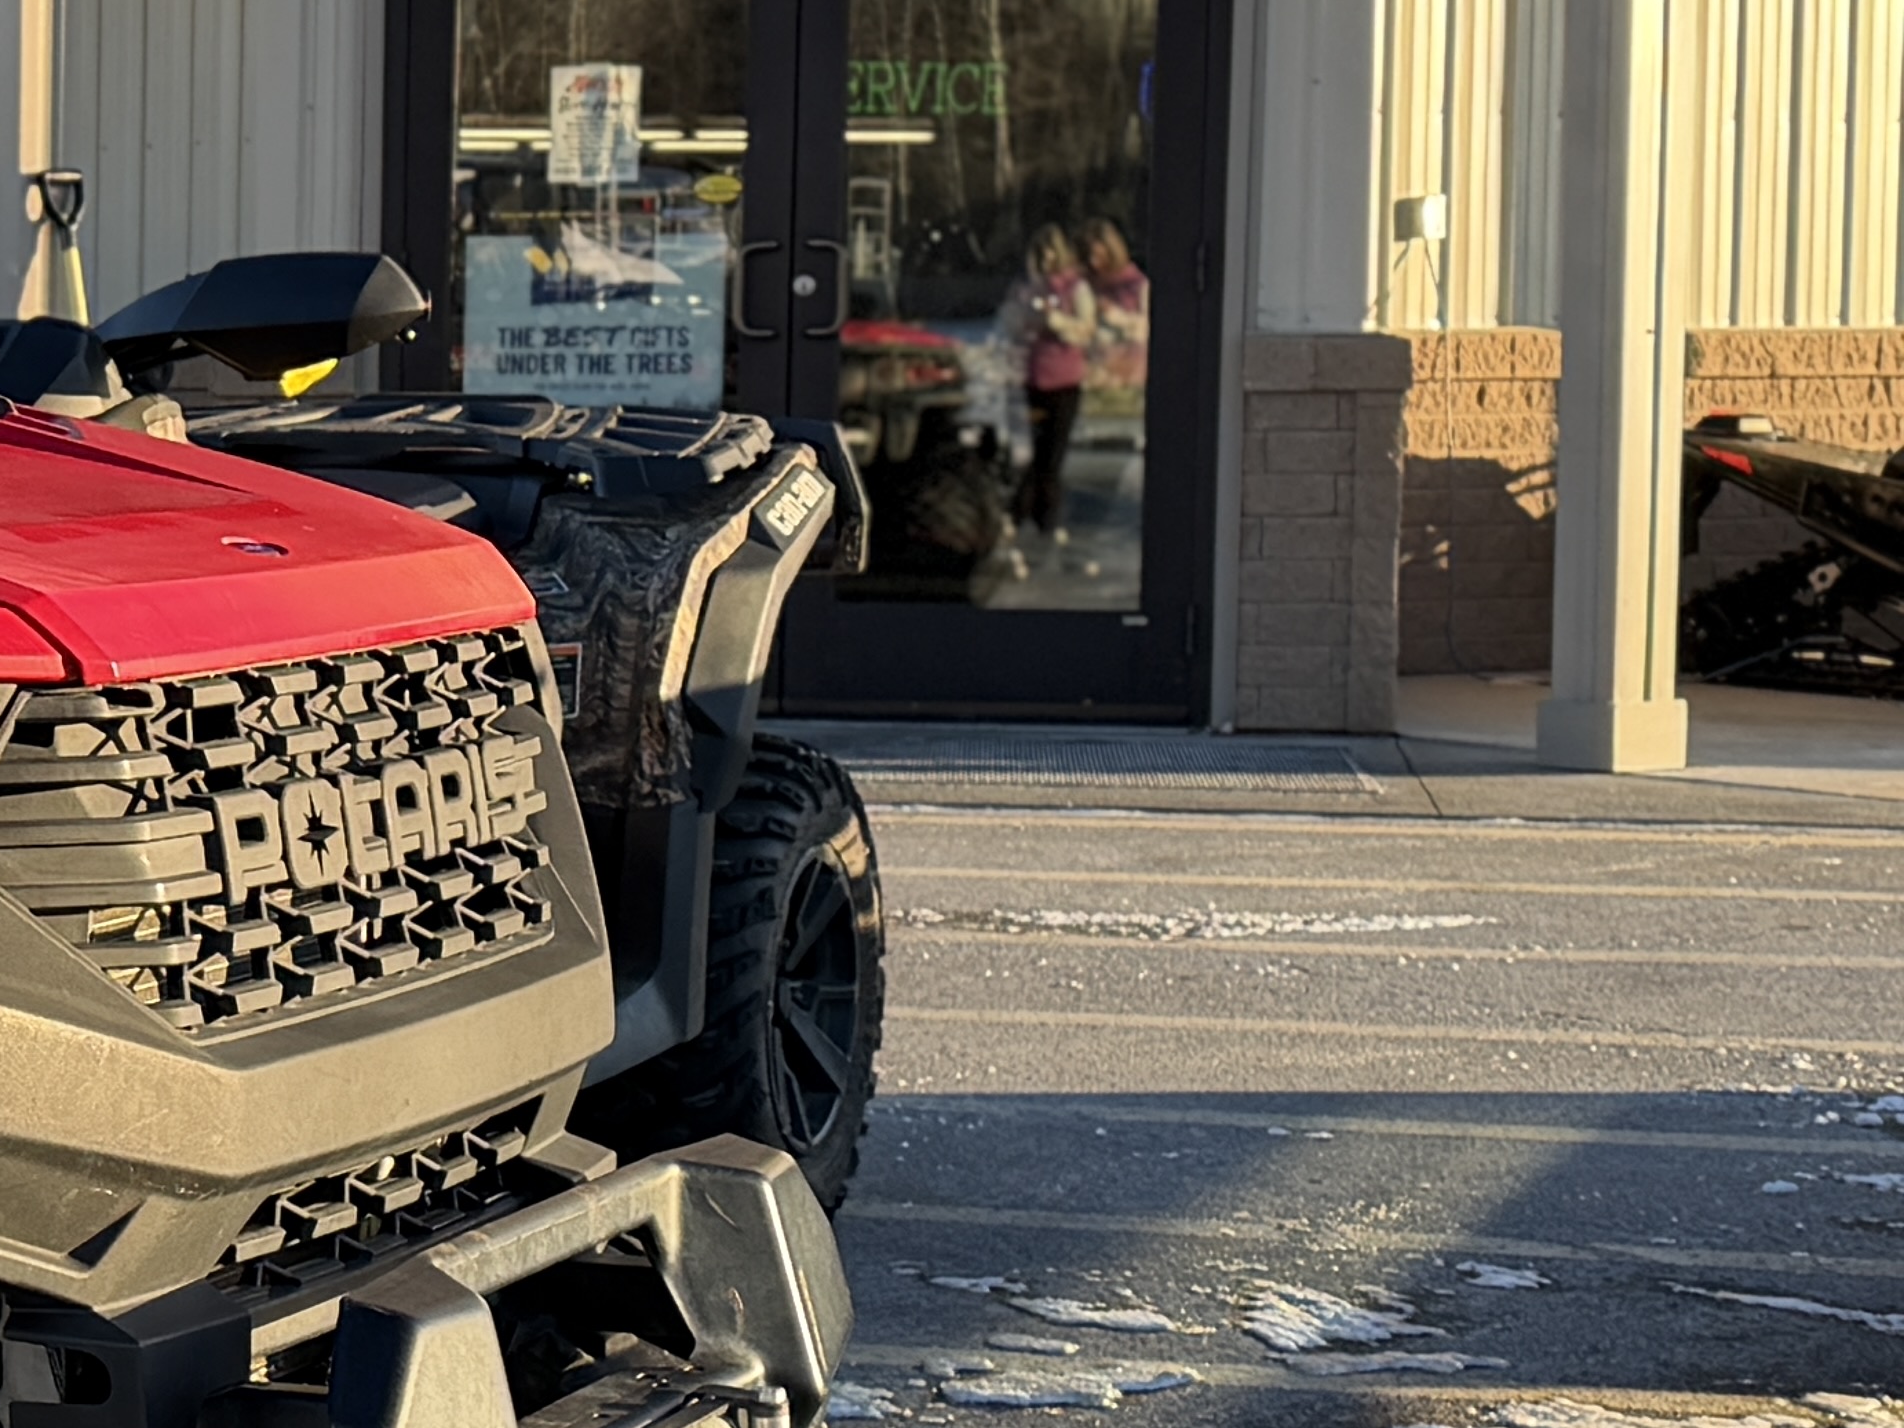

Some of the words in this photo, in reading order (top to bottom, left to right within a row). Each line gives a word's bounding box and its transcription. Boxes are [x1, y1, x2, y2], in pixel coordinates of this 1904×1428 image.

[847, 61, 1008, 114] ERVICE
[497, 327, 536, 348] THE
[542, 326, 627, 348] BEST
[496, 353, 566, 375] UNDER
[574, 353, 618, 375] THE
[626, 352, 693, 375] TREES
[214, 732, 547, 906] POLARIS
